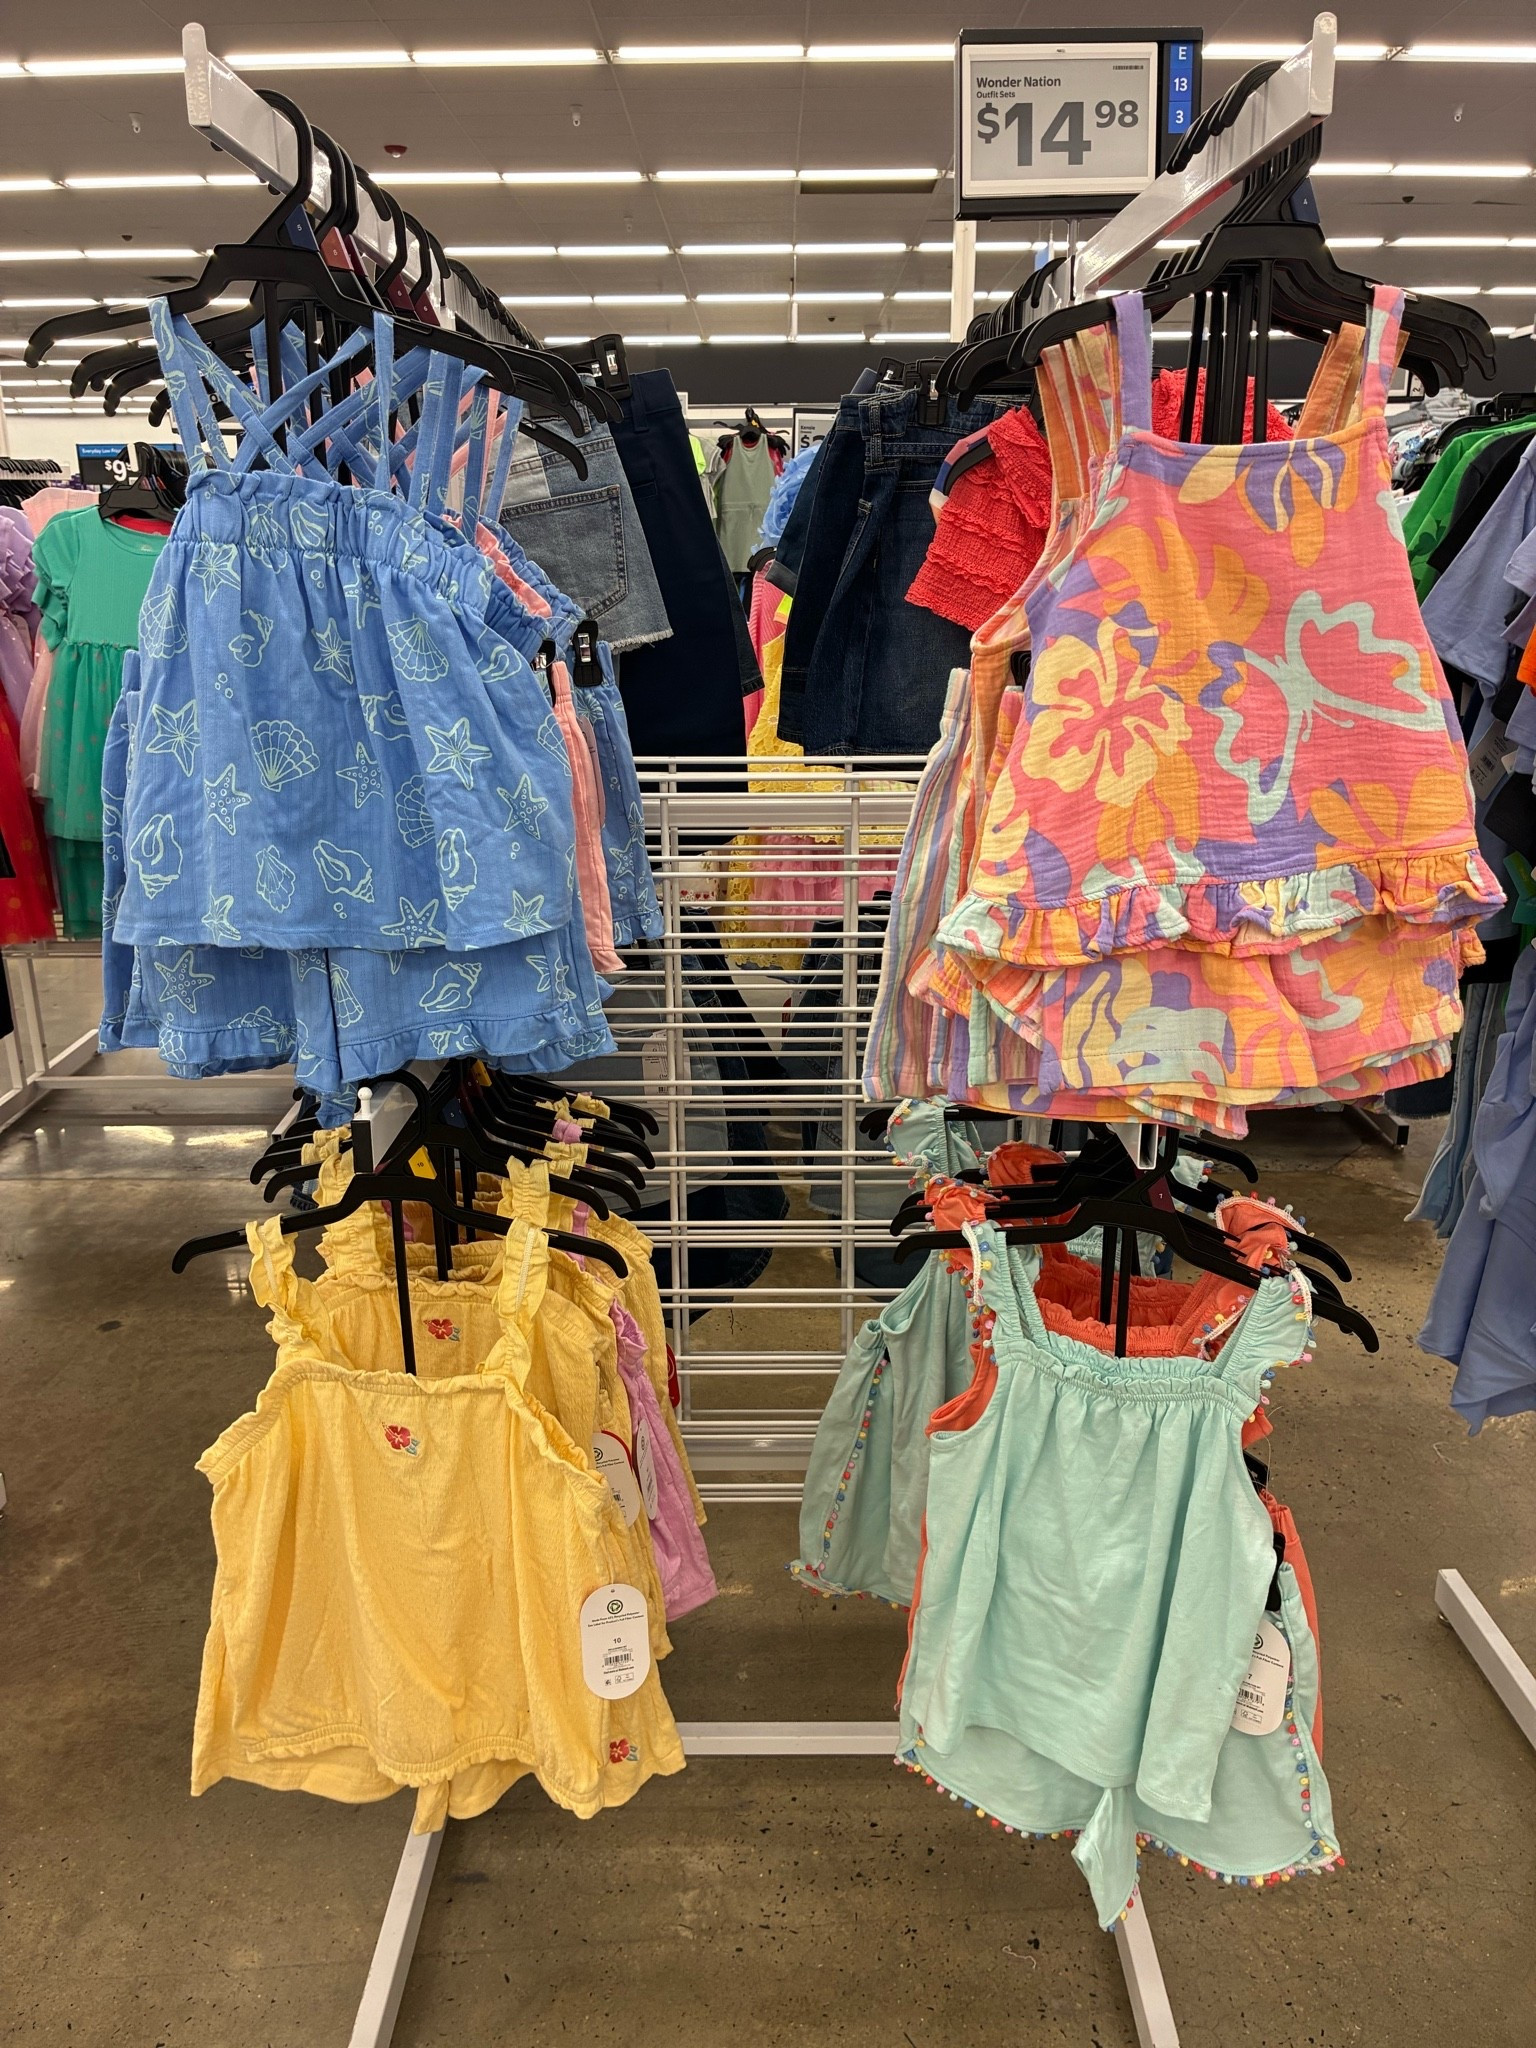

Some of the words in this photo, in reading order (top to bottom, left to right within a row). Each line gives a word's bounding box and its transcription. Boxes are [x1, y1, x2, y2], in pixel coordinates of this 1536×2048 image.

[1178, 46, 1187, 60] E
[976, 76, 1022, 88] Wonder
[1024, 76, 1061, 87] Nation
[1173, 77, 1188, 92] 13
[976, 90, 998, 99] Outfit
[999, 90, 1016, 99] Sets
[1175, 110, 1184, 124] 3
[976, 101, 1092, 167] $14
[1094, 99, 1139, 129] 98
[81, 447, 102, 455] Everyday
